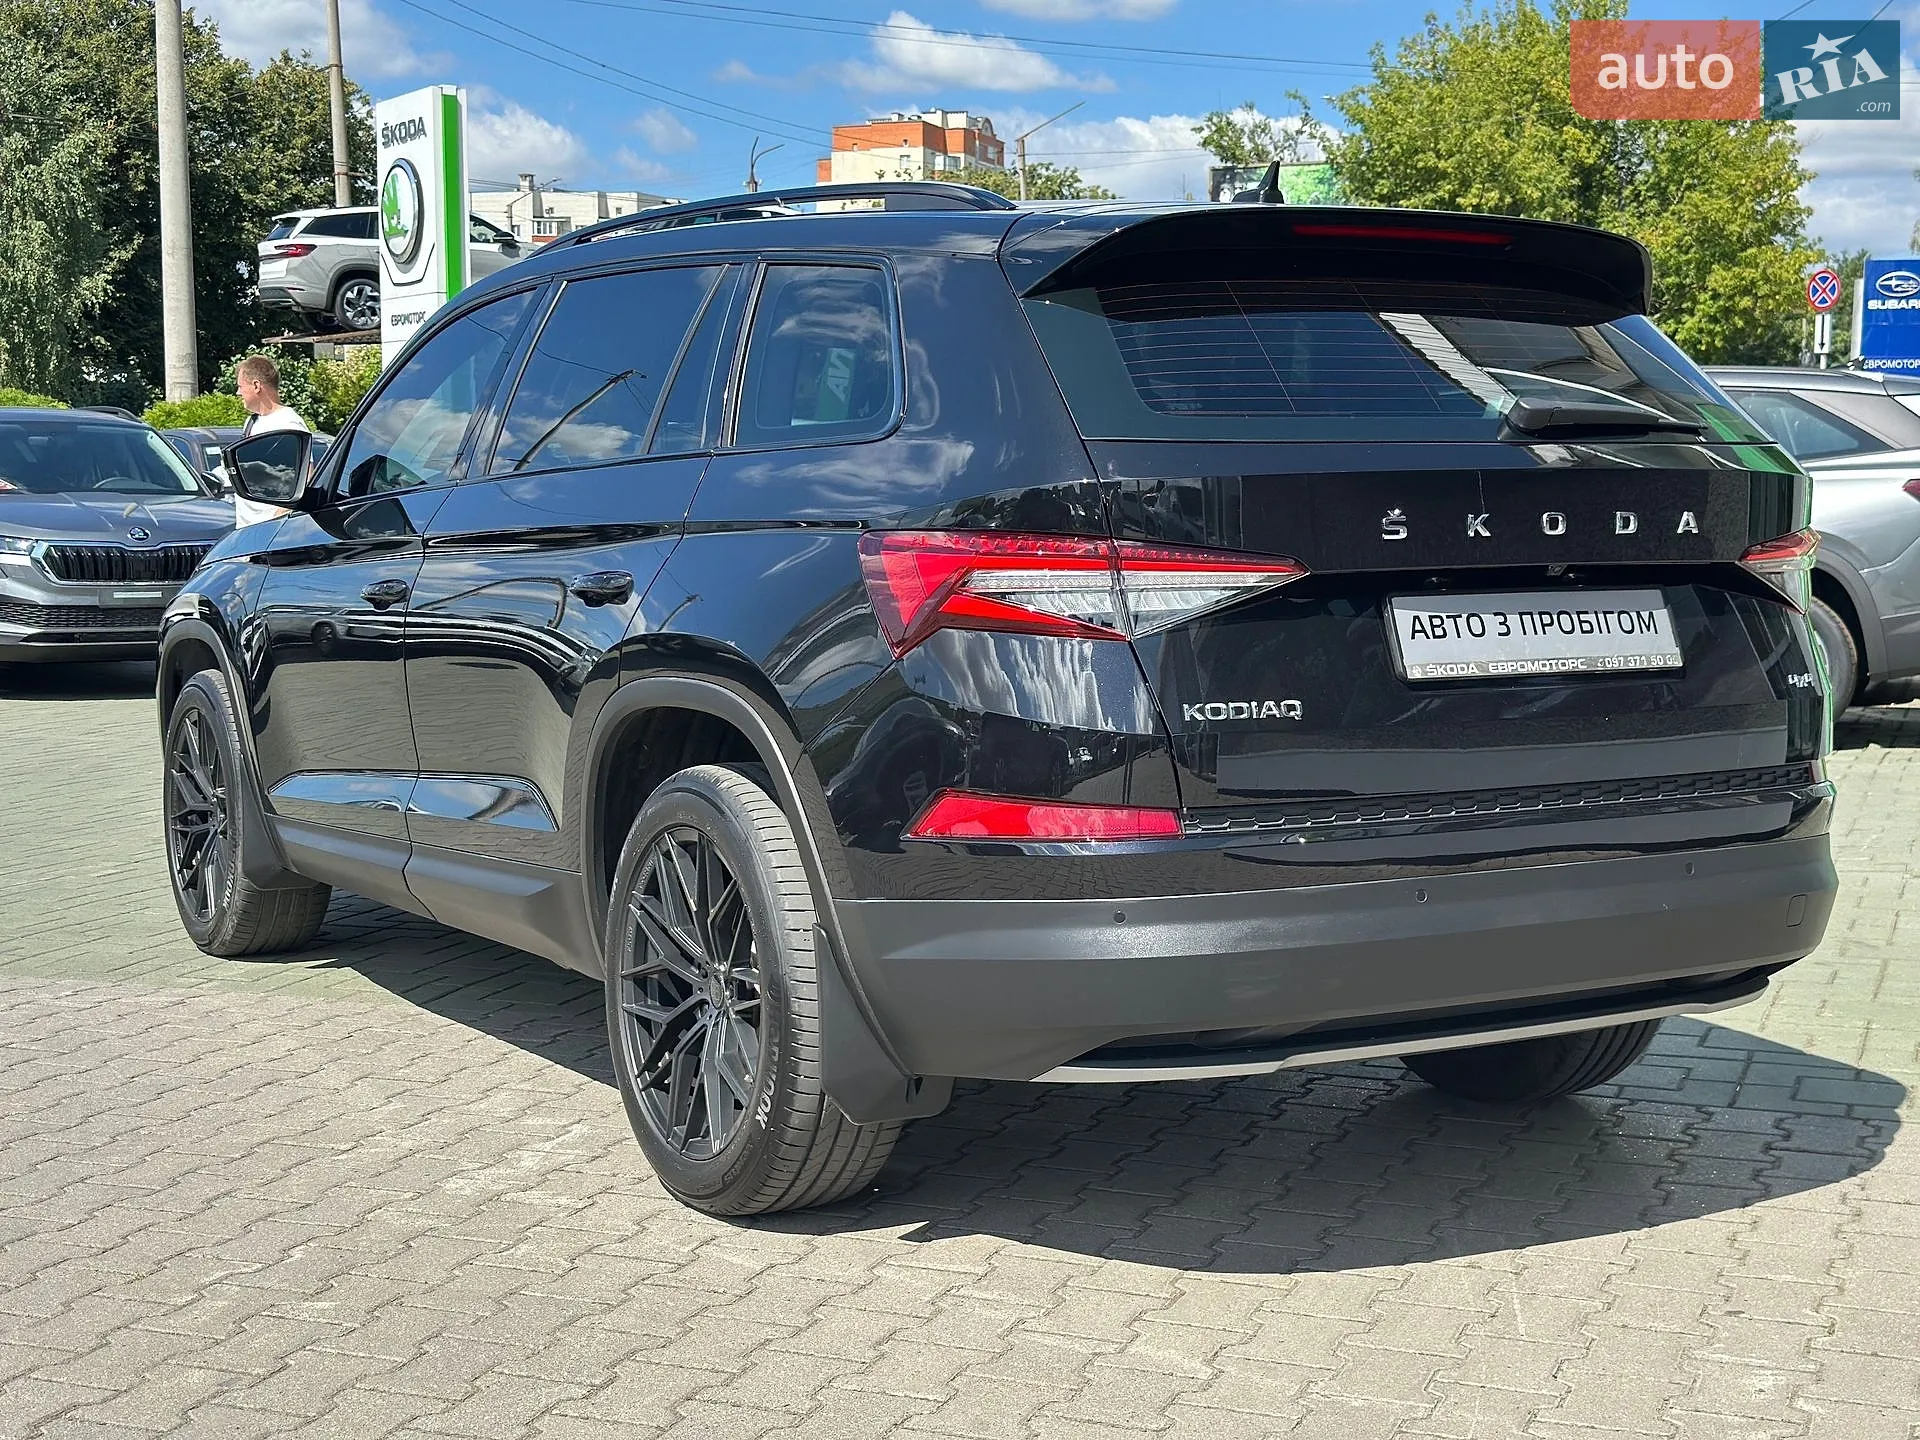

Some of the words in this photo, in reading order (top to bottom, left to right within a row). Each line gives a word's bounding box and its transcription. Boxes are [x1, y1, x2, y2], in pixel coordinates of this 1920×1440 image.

[381, 116, 427, 149] ŠKODA
[1410, 612, 1487, 640] АВТО
[1519, 610, 1659, 637] ПРОБІГОМ
[1426, 664, 1480, 676] ŠKODA
[1182, 699, 1303, 721] KODIAQ
